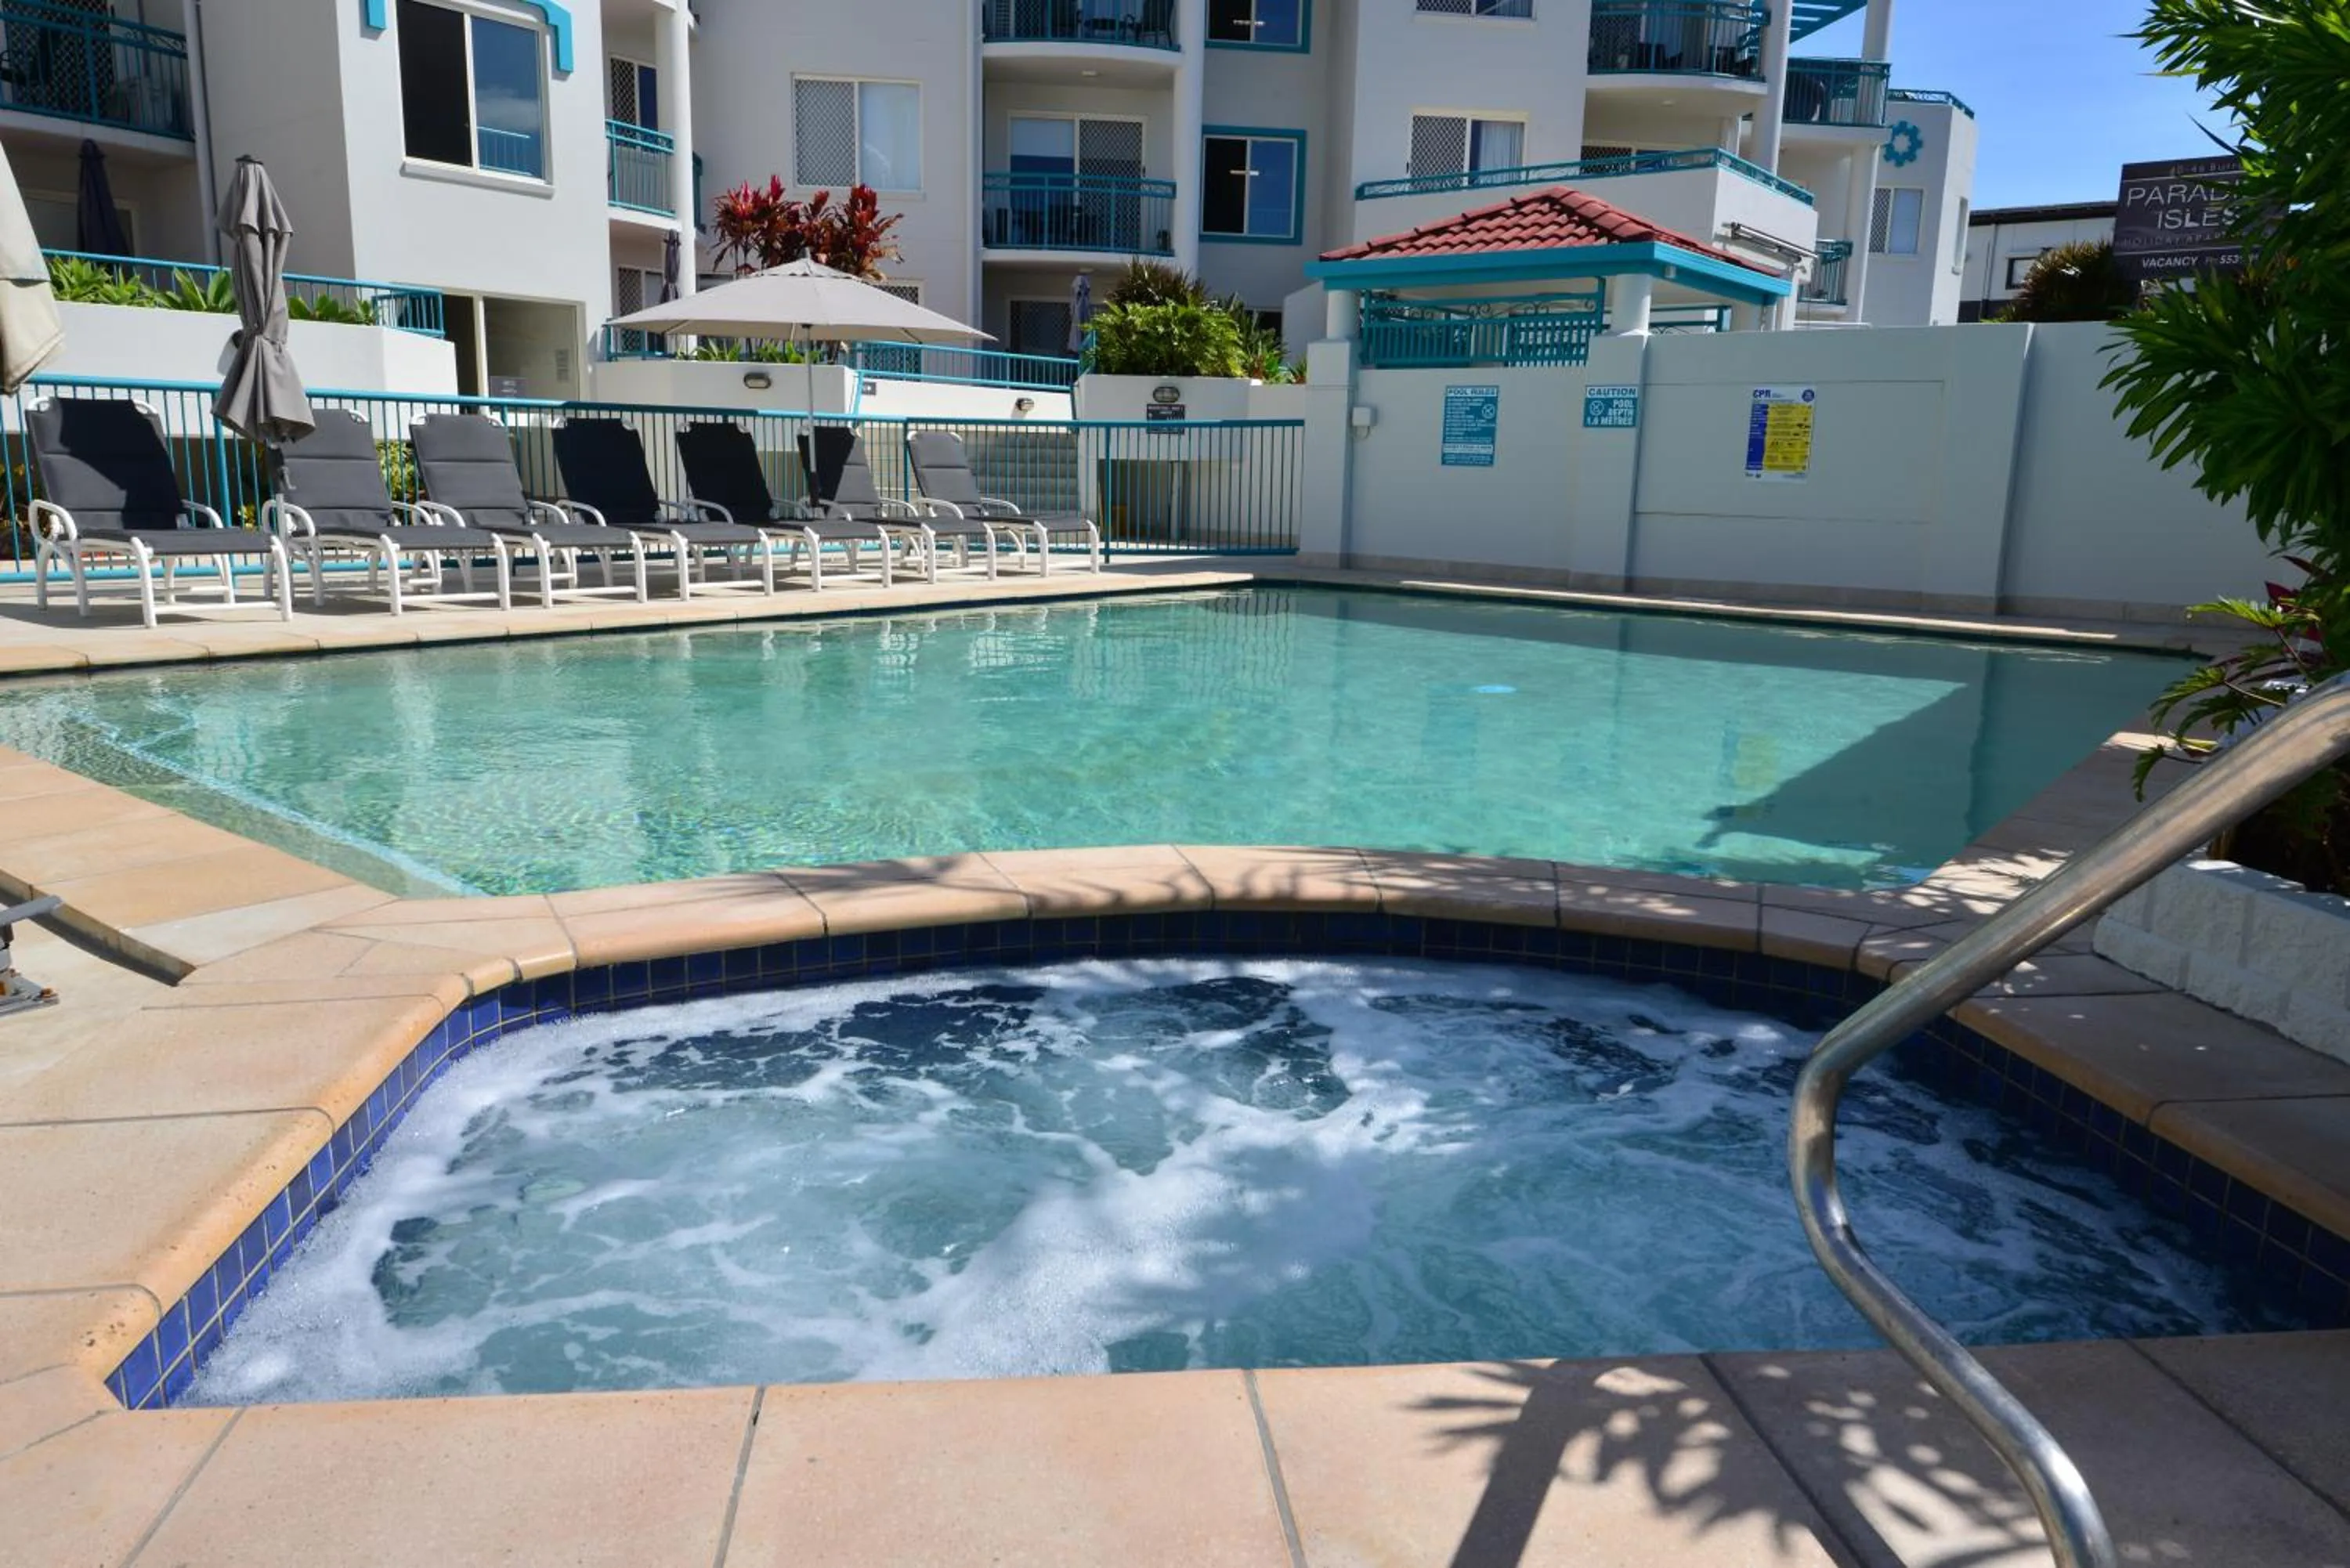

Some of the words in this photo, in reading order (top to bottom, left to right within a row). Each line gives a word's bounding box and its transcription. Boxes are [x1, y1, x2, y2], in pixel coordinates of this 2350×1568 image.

[2127, 180, 2249, 207] PARADI
[2157, 206, 2240, 229] ISLES
[2142, 255, 2199, 269] VACANCY
[1753, 389, 1771, 399] CPR
[1613, 399, 1634, 408] POOL
[1607, 407, 1634, 417] DEPTH
[1600, 416, 1634, 425] METRES
